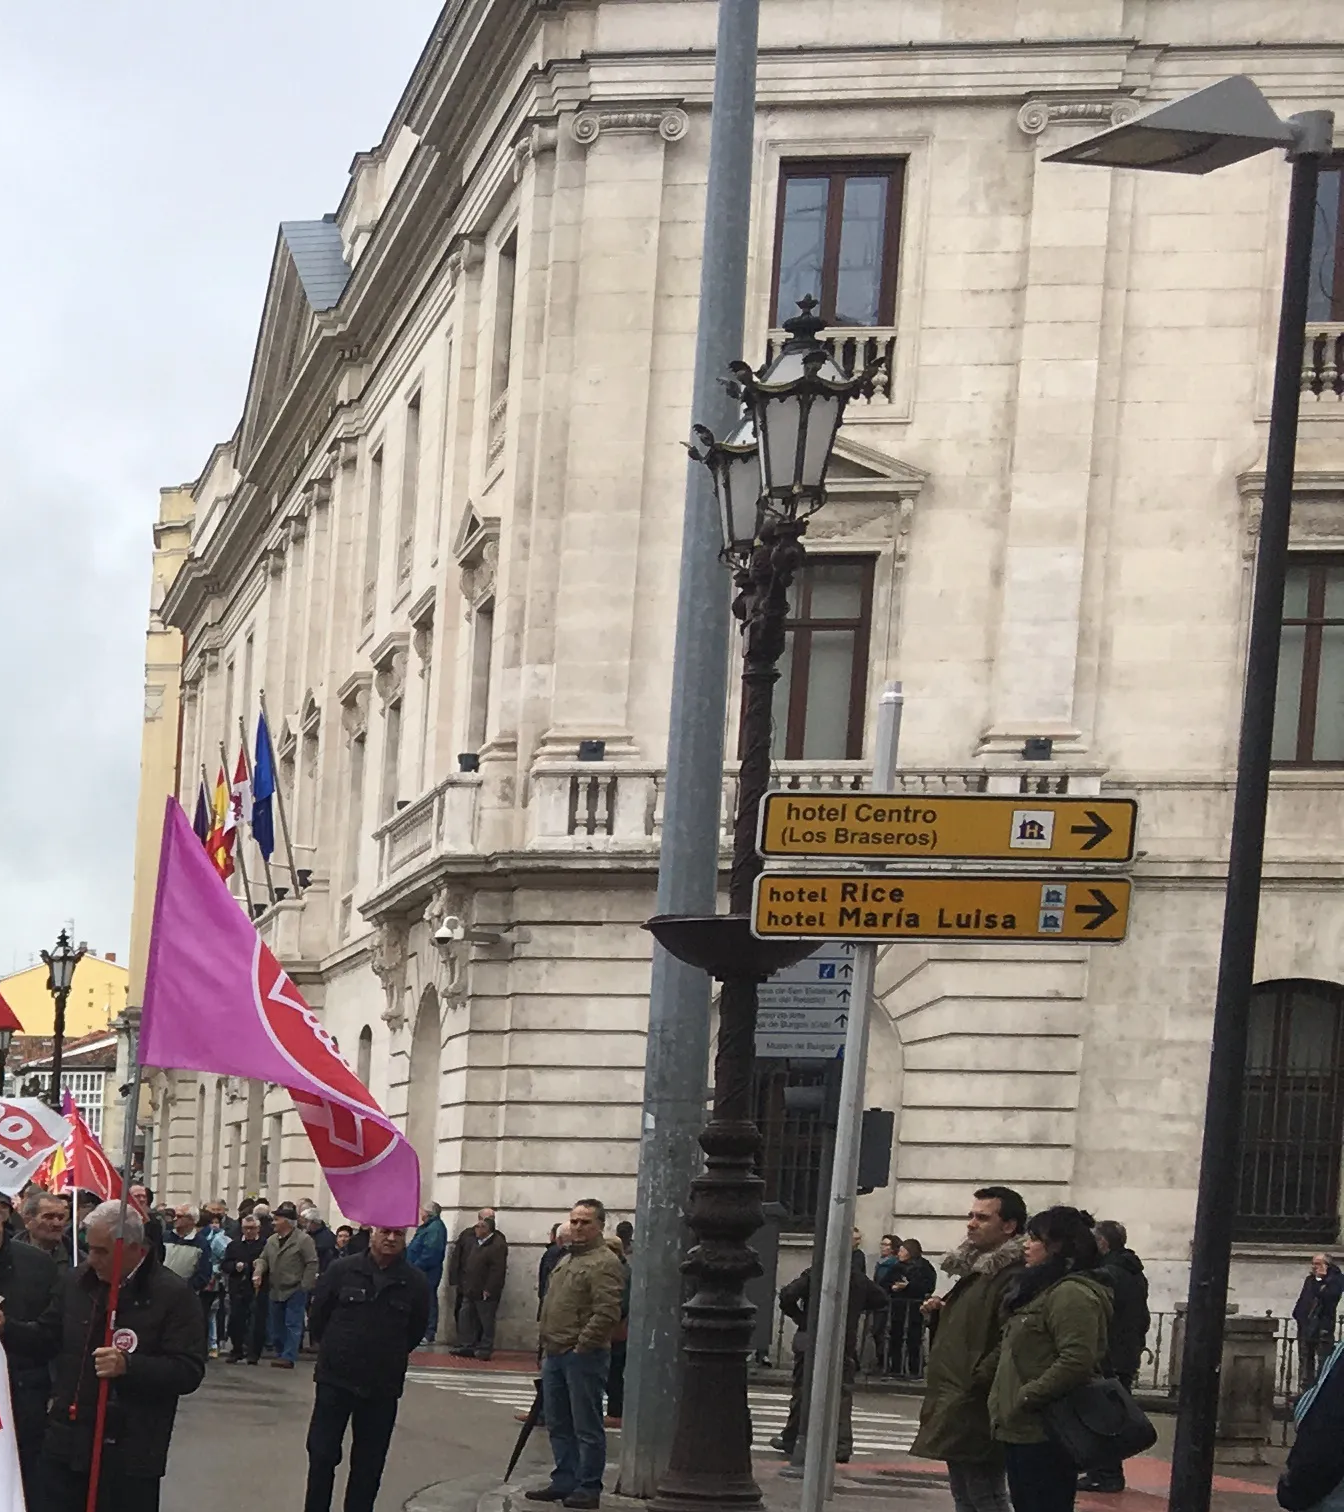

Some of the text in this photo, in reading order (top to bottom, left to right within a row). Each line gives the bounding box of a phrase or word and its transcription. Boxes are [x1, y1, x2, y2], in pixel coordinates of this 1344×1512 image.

[786, 803, 937, 824] hotel Centro
[780, 827, 938, 849] (Los Braseros)
[769, 882, 904, 903] hotel Rice
[767, 906, 1016, 930] hotel María Luisa
